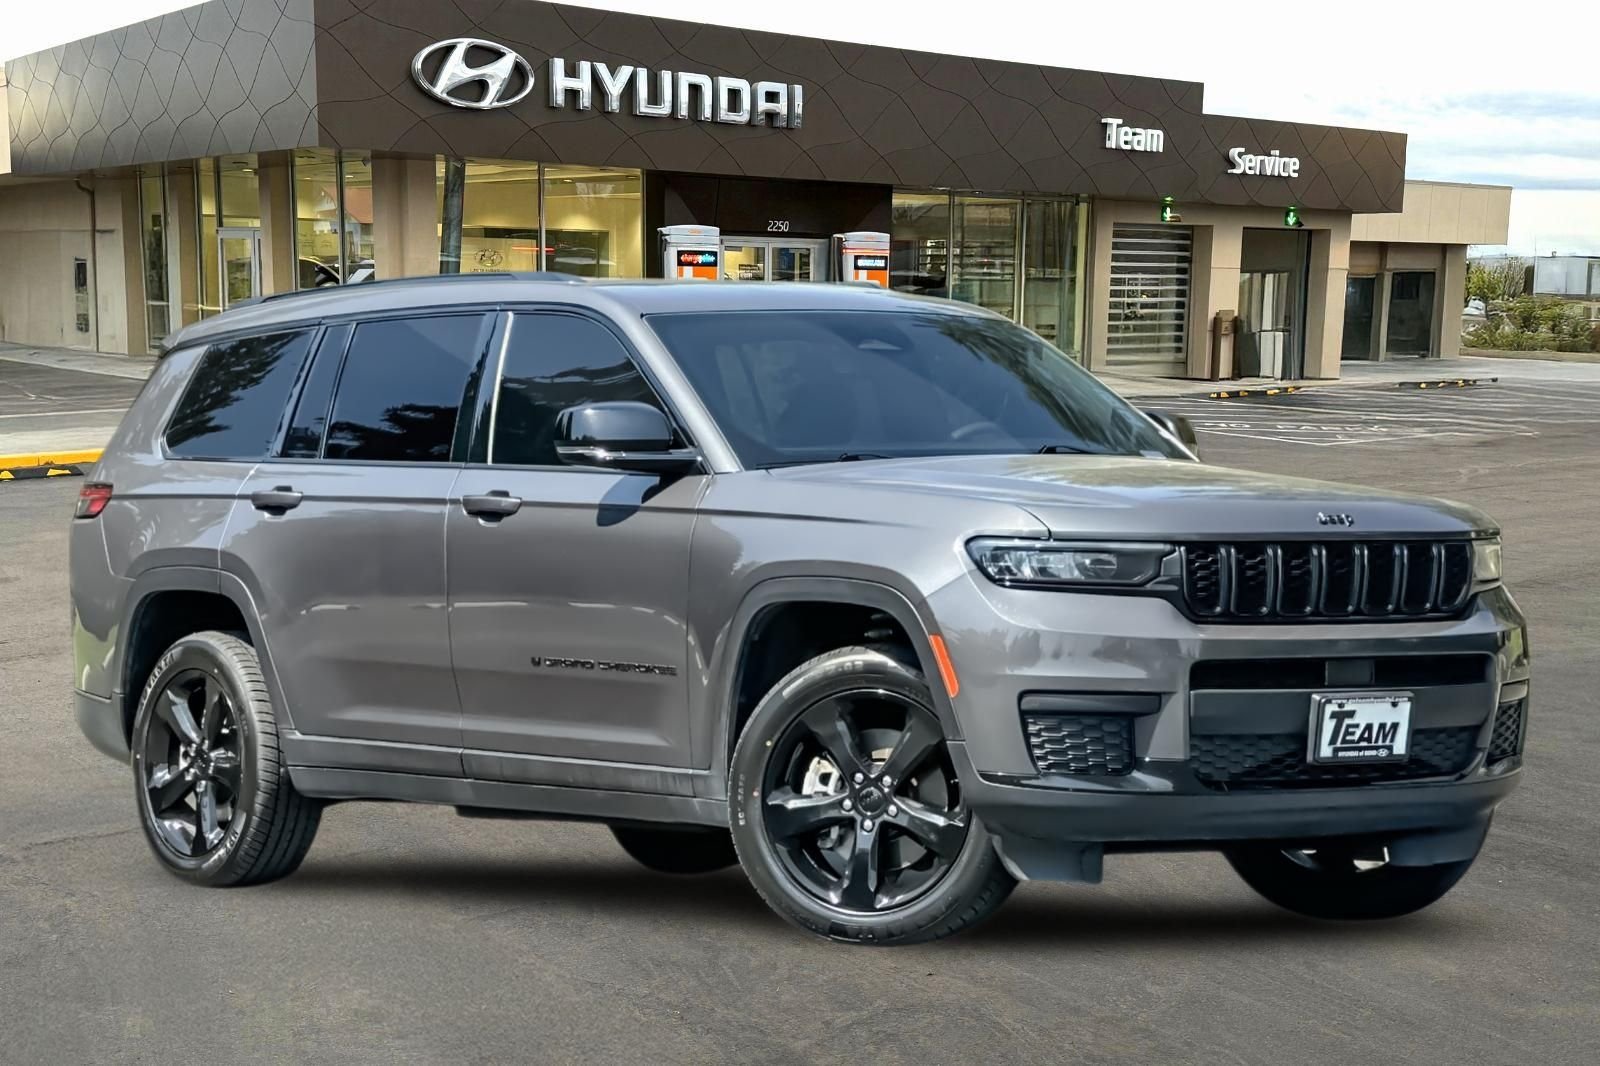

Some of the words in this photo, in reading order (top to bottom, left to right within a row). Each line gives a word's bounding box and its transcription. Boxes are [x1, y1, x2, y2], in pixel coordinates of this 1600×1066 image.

[549, 57, 803, 129] HYUNDAI
[1101, 117, 1165, 153] Team
[1227, 147, 1300, 178] Service
[767, 220, 790, 232] 2250
